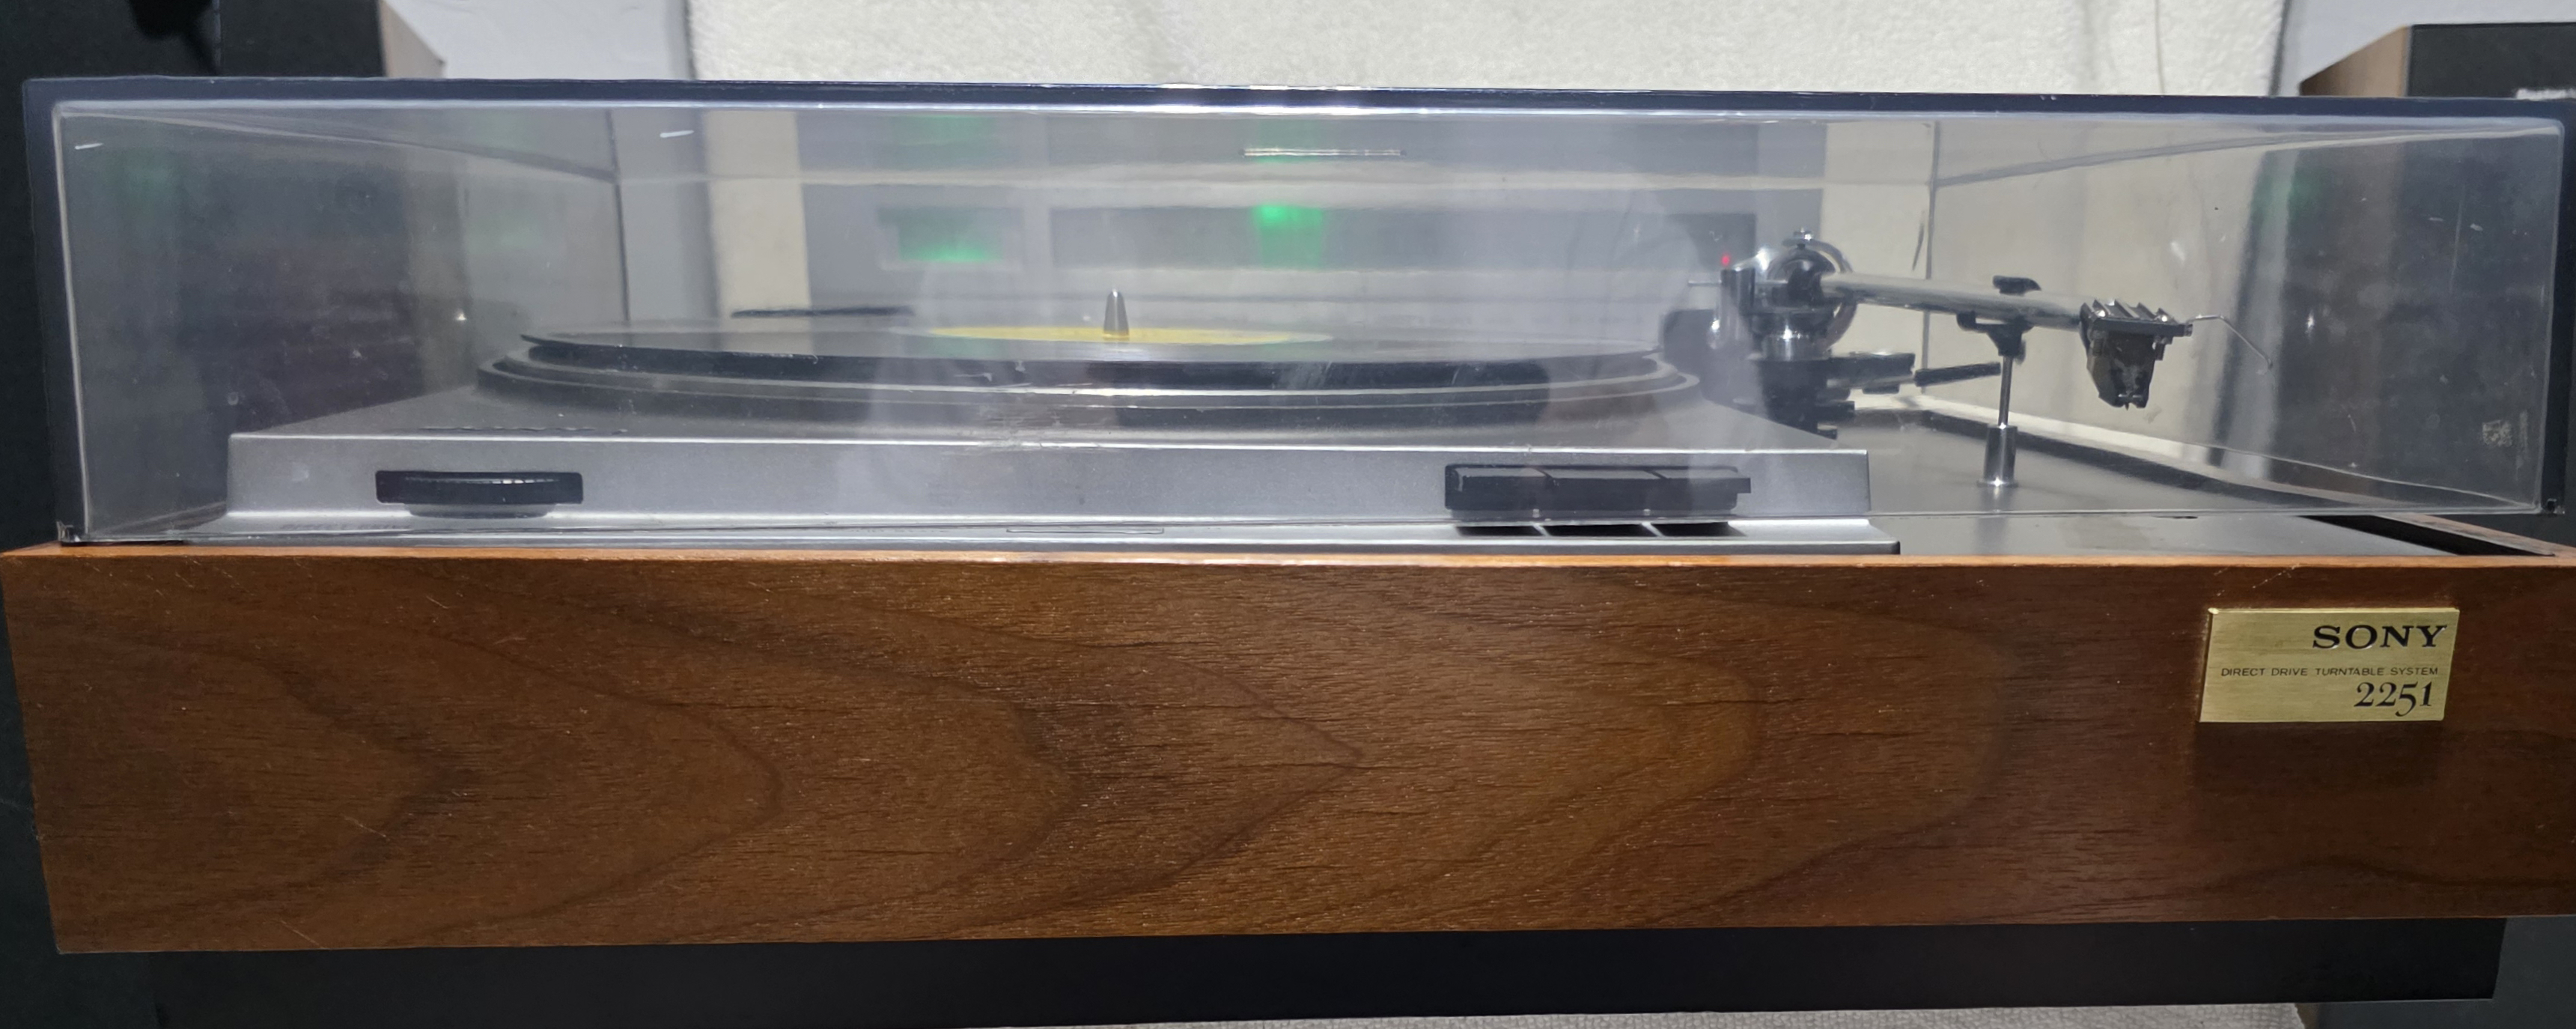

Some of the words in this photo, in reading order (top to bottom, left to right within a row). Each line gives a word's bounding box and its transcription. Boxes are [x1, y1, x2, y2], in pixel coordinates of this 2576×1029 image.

[2312, 625, 2447, 649] SONY
[2220, 667, 2266, 677] DIRECT
[2271, 667, 2309, 676] DRIVE
[2315, 667, 2385, 676] TURNTABLE
[2390, 667, 2438, 676] SYSTEM
[2353, 682, 2433, 717] 2251
